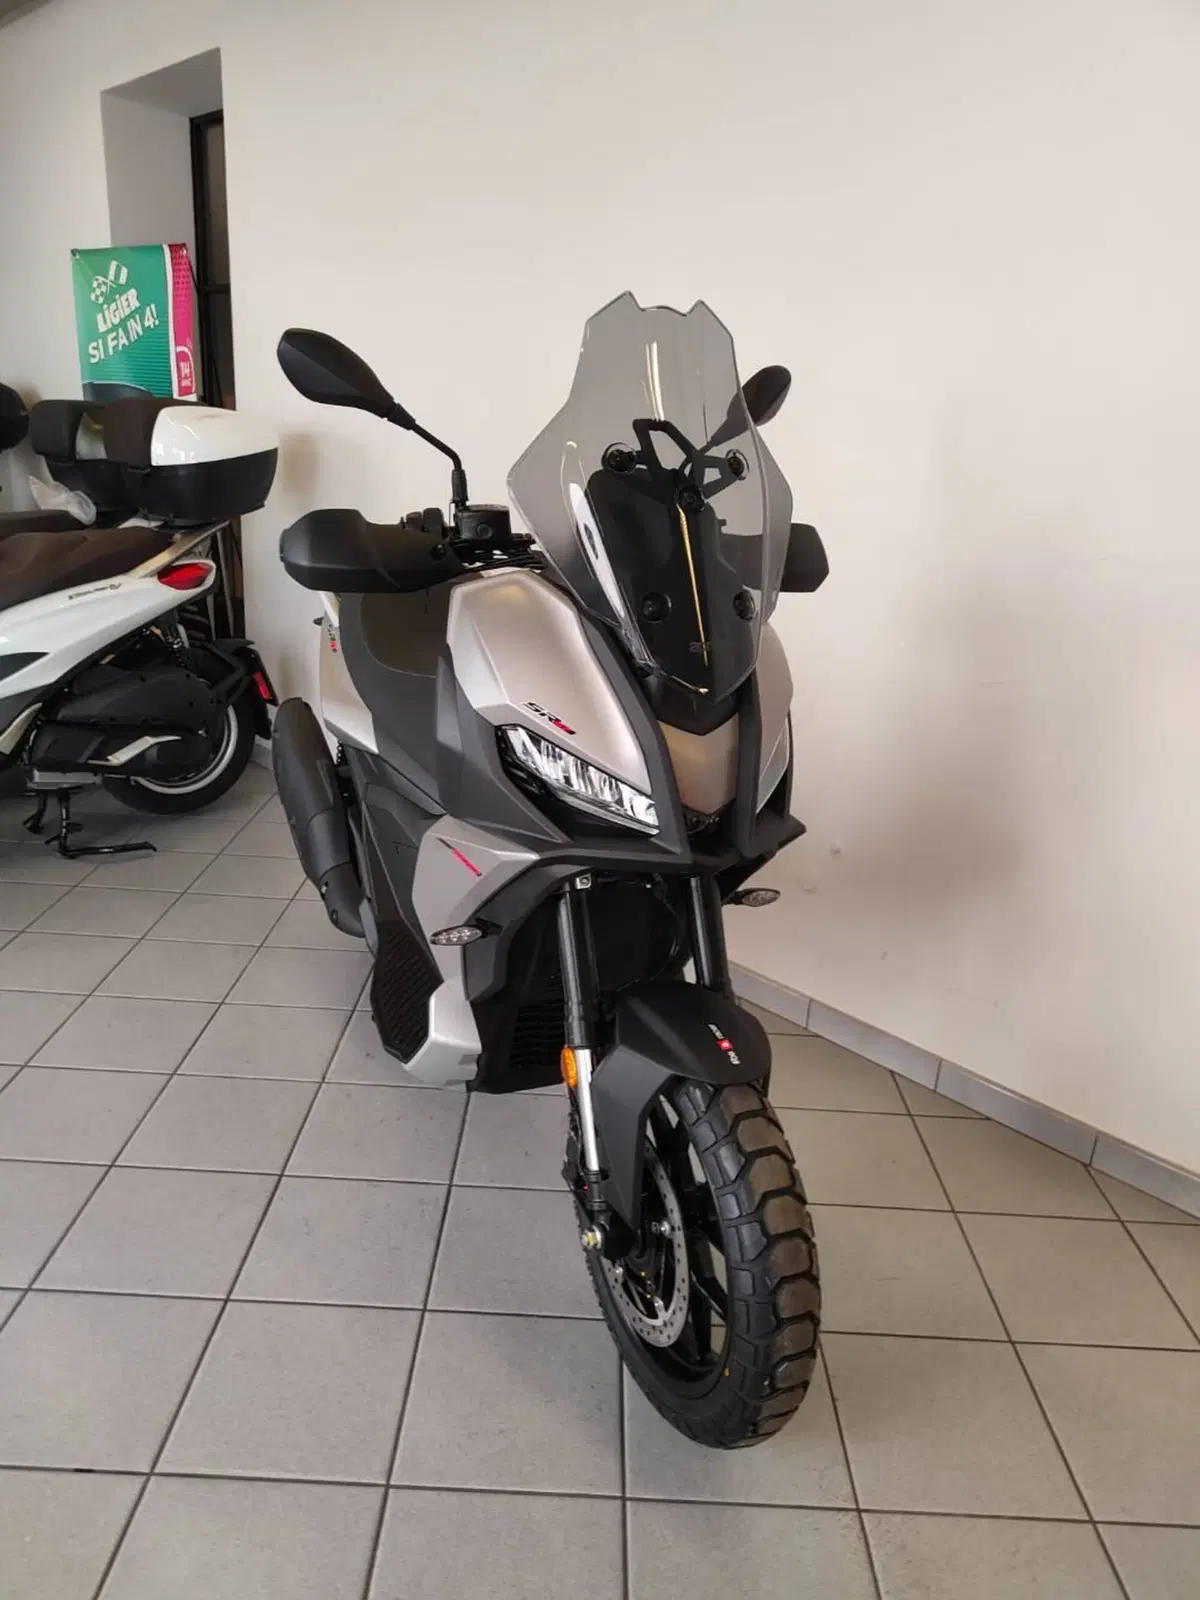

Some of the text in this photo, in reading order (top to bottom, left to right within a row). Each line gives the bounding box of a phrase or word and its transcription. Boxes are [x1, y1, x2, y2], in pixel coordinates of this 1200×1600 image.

[88, 303, 160, 364] SI FA IN 4!
